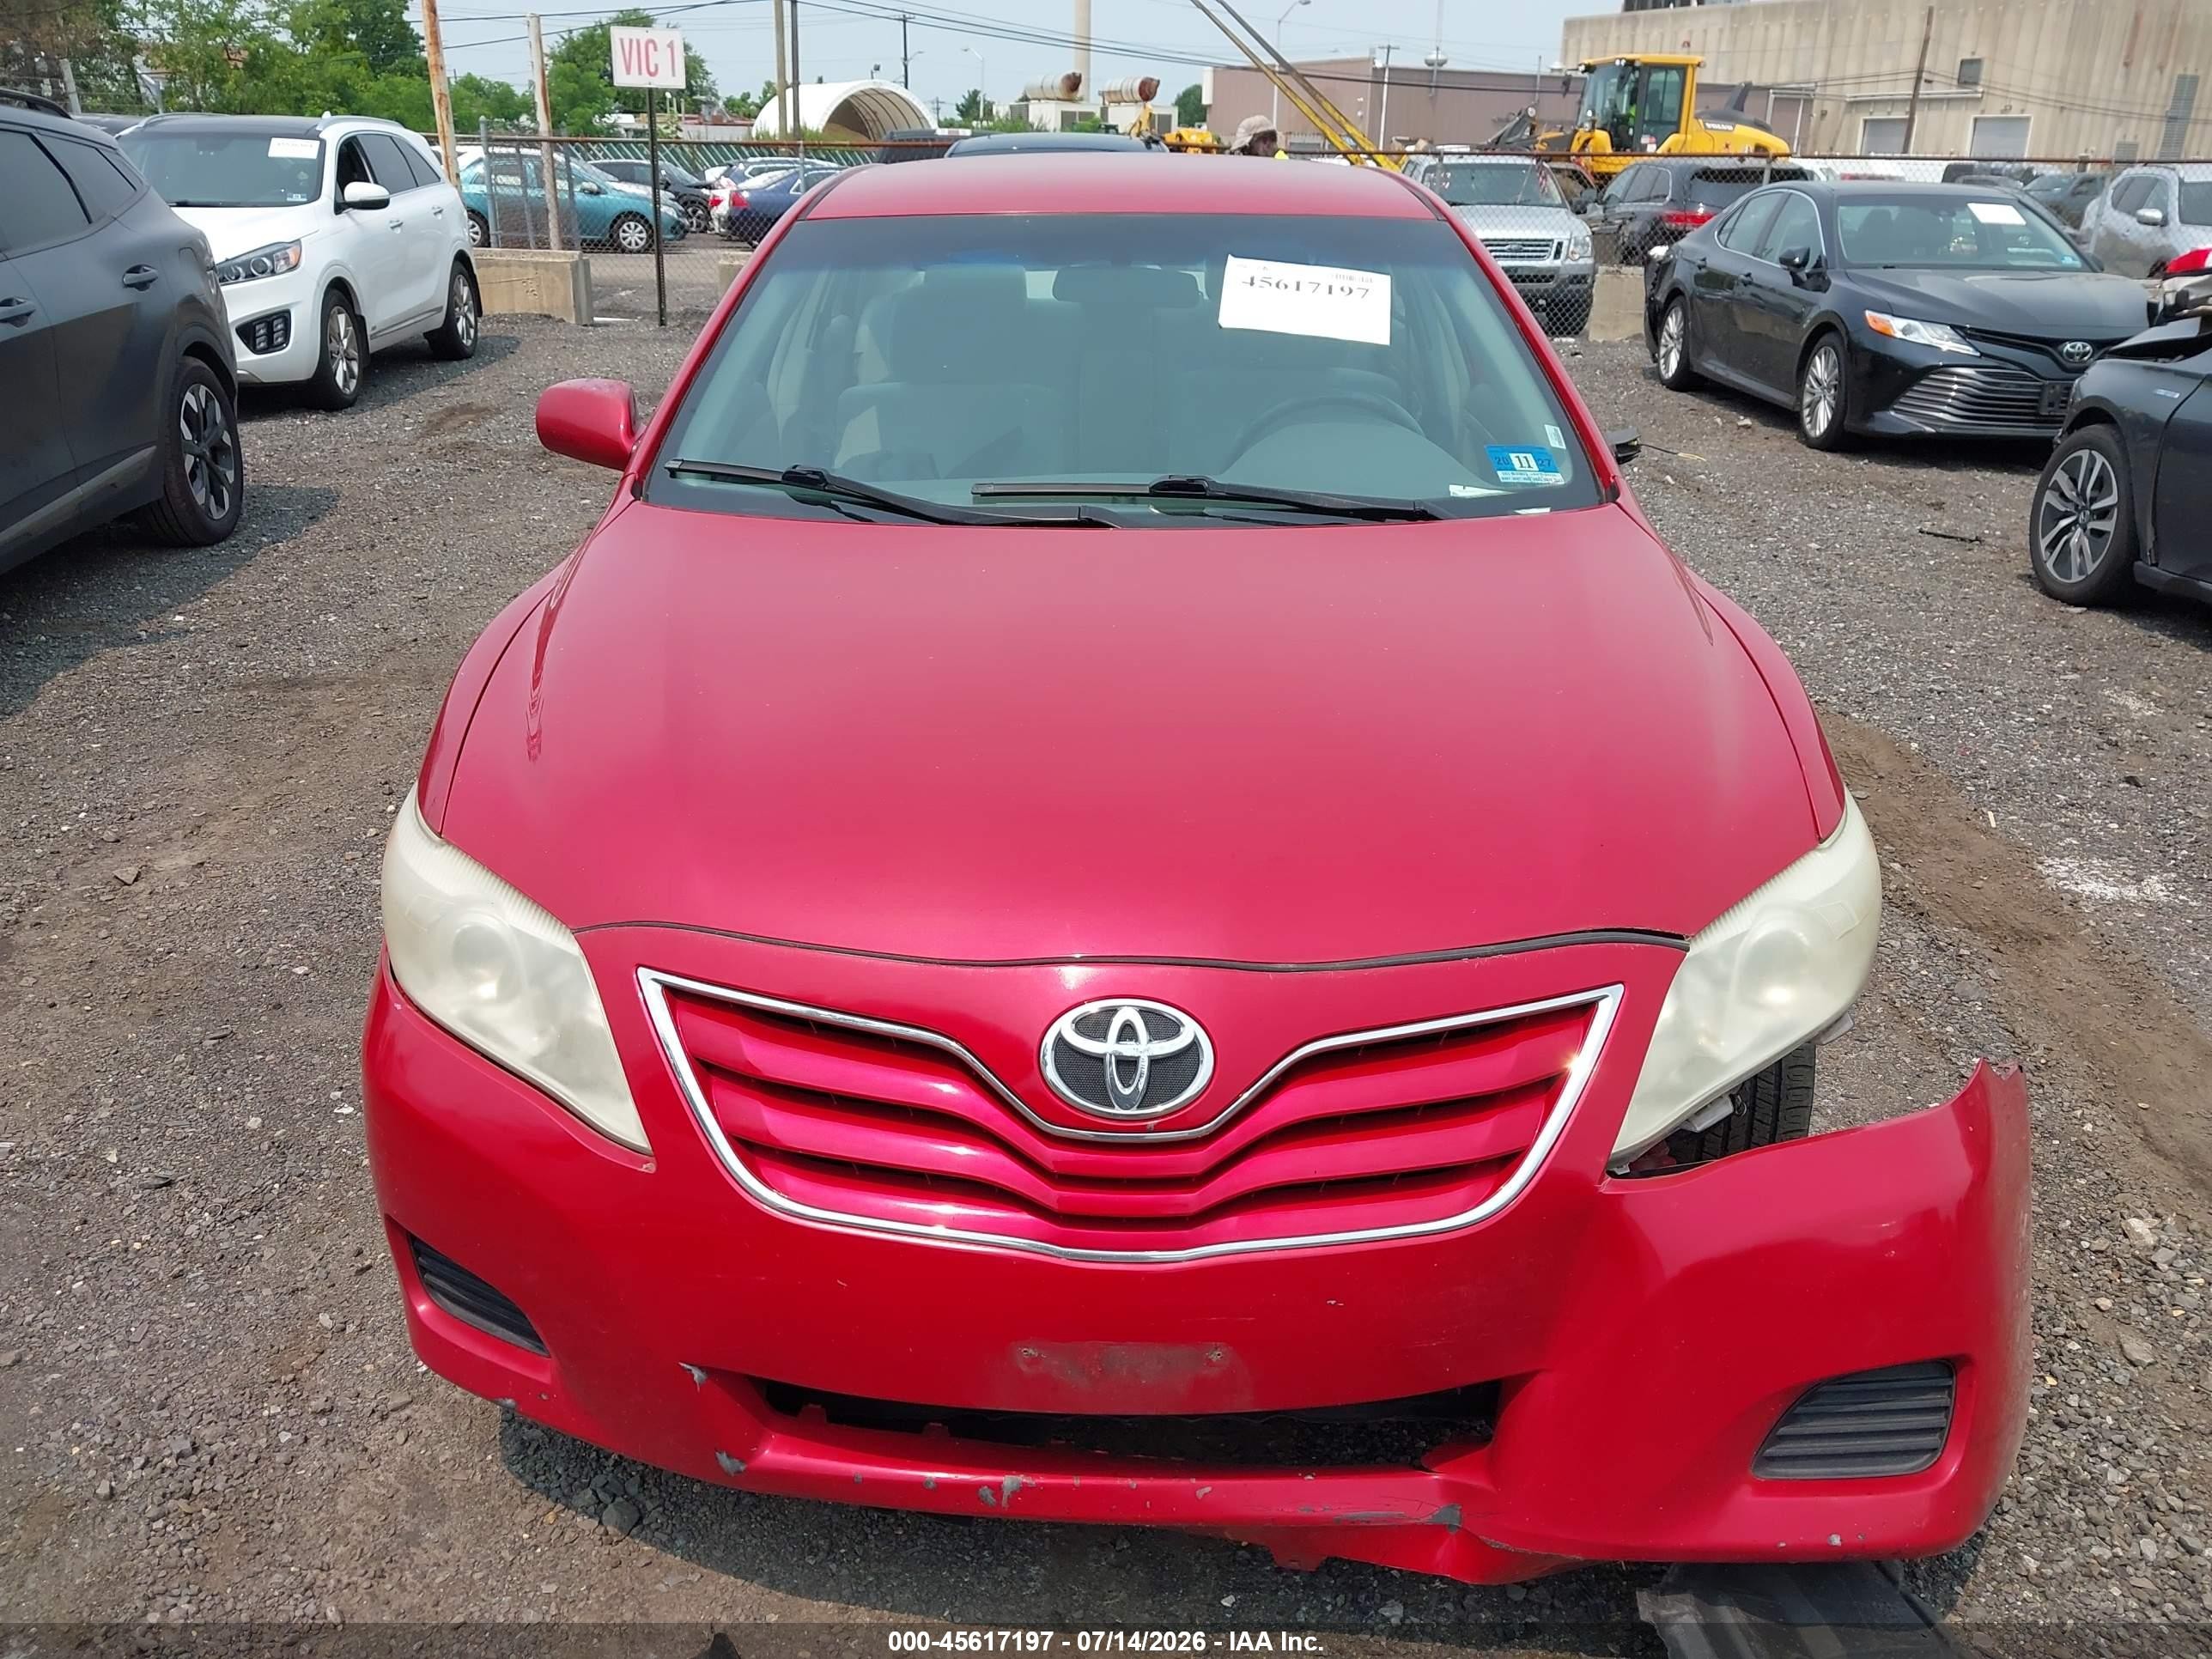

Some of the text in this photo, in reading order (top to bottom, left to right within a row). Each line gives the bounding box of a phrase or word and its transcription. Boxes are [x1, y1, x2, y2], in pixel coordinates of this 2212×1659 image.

[619, 38, 676, 77] VIC 1
[1242, 275, 1370, 299] 45617197
[1515, 455, 1534, 469] 11
